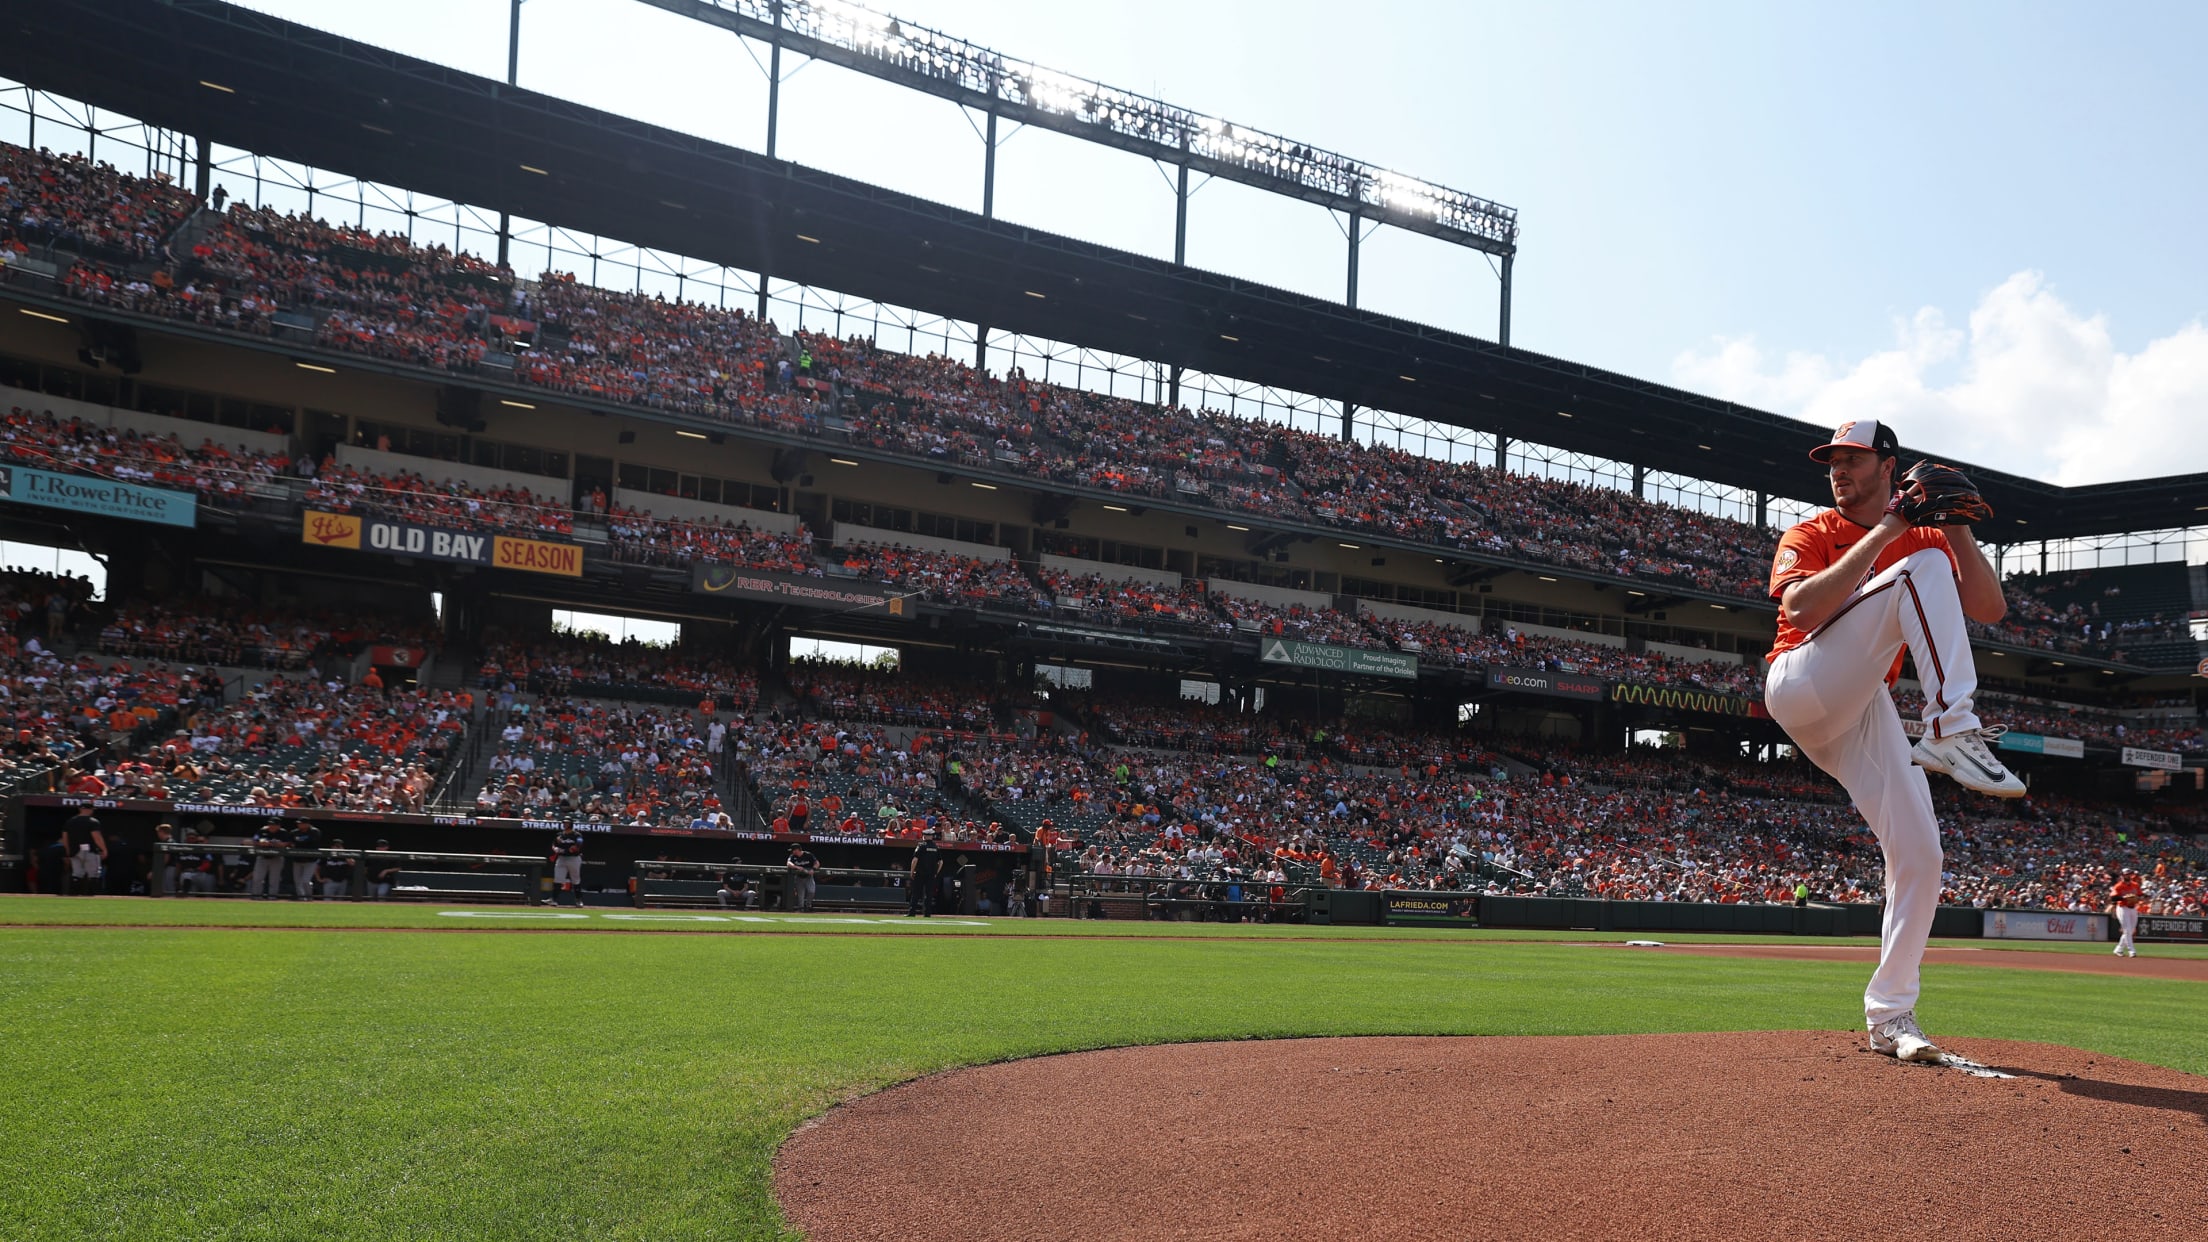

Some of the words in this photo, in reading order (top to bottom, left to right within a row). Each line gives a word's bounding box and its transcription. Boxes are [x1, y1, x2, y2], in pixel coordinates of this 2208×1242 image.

[71, 500, 97, 509] WITH
[101, 504, 166, 519] CONFIDENCE
[311, 515, 354, 544] It's
[370, 523, 426, 553] OLD
[432, 531, 485, 560] BAY
[500, 540, 575, 572] SEASON
[1295, 643, 1344, 659] ADVANCED
[1293, 654, 1346, 670] RADIOLOGY
[1363, 654, 1381, 663] Proud
[1382, 656, 1407, 668] Imaging
[1353, 662, 1375, 672] Partner
[1376, 665, 1384, 673] of
[1384, 666, 1394, 675] the
[1394, 667, 1415, 676] Orioles
[1494, 672, 1547, 689] ubeo.com
[1557, 681, 1599, 694] SHARP
[2136, 752, 2165, 763] DEFENDER
[2167, 756, 2179, 765] ONE
[173, 802, 220, 815] STREAM
[221, 805, 259, 817] GAMES
[261, 807, 285, 817] LIVE
[521, 820, 560, 831] STREAM
[592, 826, 612, 834] LIVE
[809, 835, 841, 845] STREAM
[842, 836, 866, 846] GAMES
[867, 838, 885, 846] LIVE
[1390, 901, 1449, 910] LAFRIEDA.COM
[2047, 918, 2076, 935] Chill
[2151, 920, 2187, 932] DEFENDER
[2188, 921, 2203, 932] ONE
